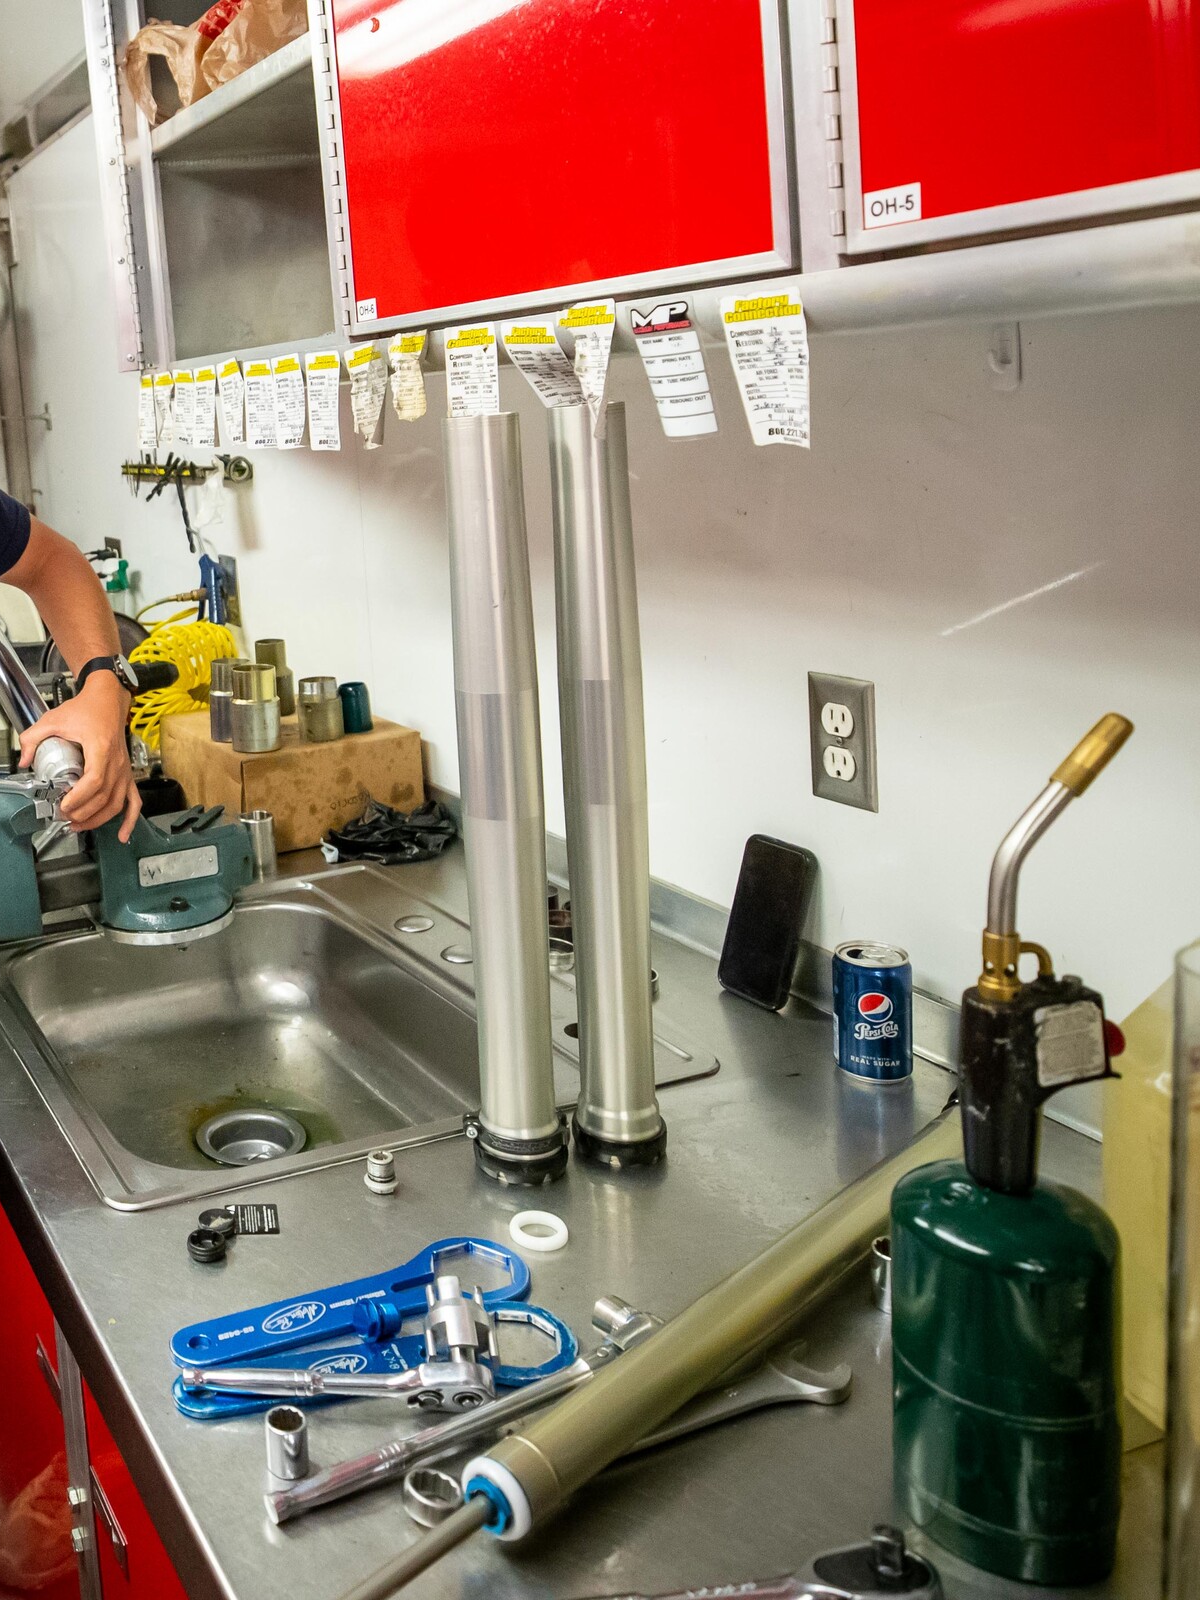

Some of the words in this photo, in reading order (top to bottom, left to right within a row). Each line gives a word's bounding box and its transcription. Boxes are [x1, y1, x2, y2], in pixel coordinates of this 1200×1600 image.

[871, 194, 915, 217] OH-5
[359, 304, 375, 316] OH-6
[735, 294, 789, 312] Factory
[631, 301, 688, 327] MP
[850, 1055, 870, 1066] REAL
[292, 1303, 318, 1321] Motion
